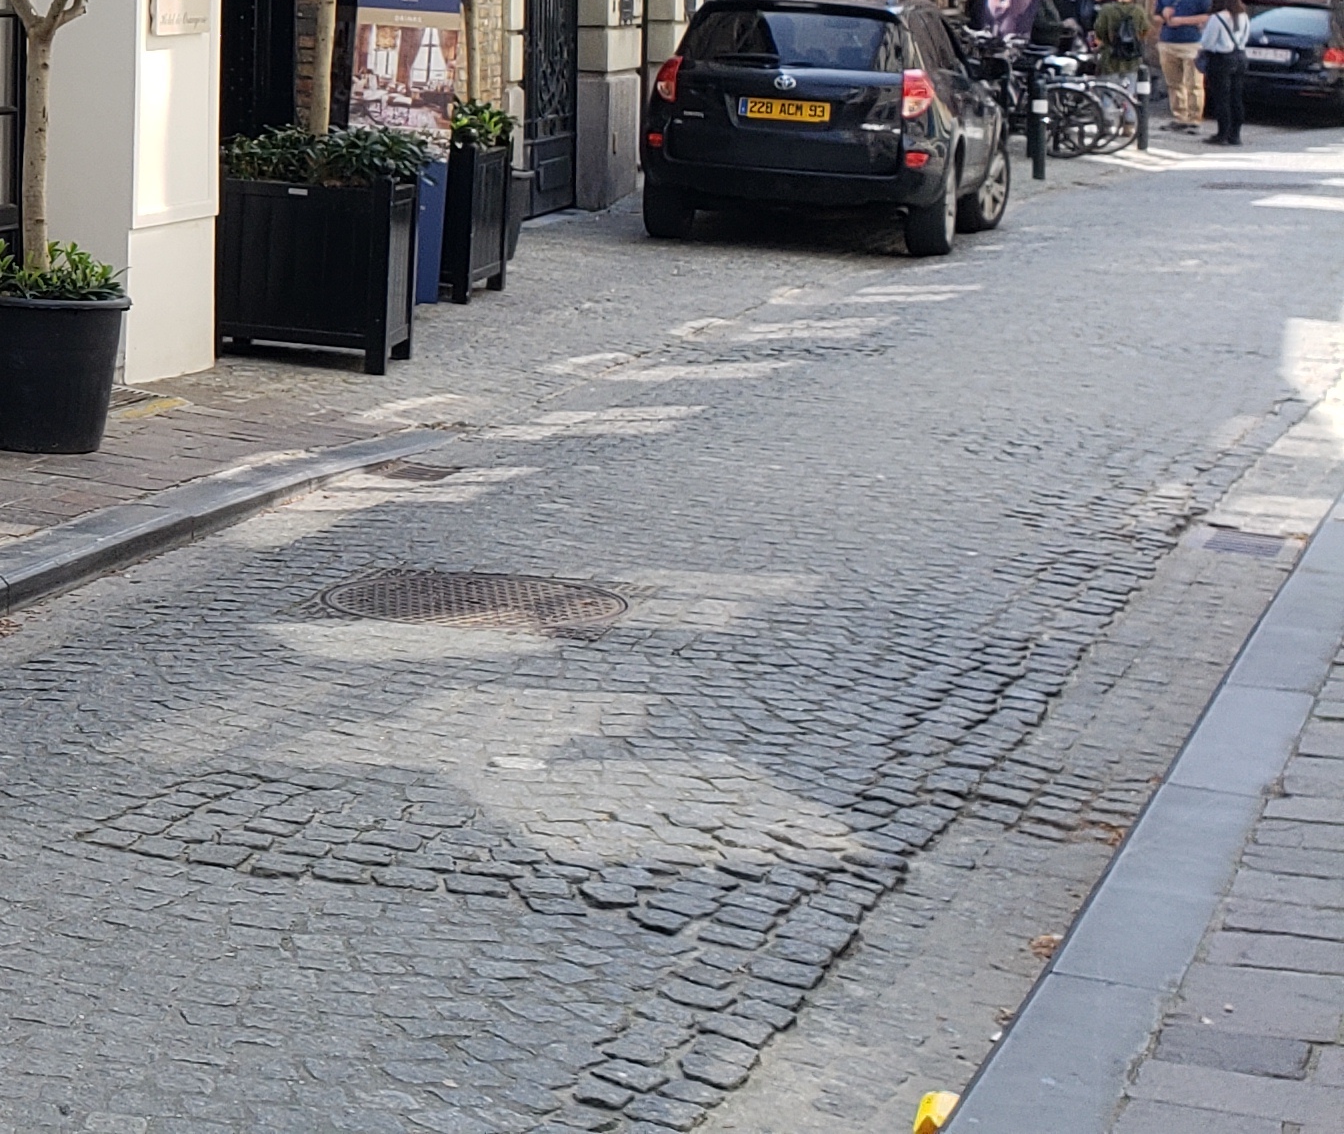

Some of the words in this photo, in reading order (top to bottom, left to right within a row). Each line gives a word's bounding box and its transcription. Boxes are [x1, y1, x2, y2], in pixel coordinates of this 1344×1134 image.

[749, 100, 773, 114] 228
[779, 103, 803, 117] ACM
[808, 104, 825, 118] 93
